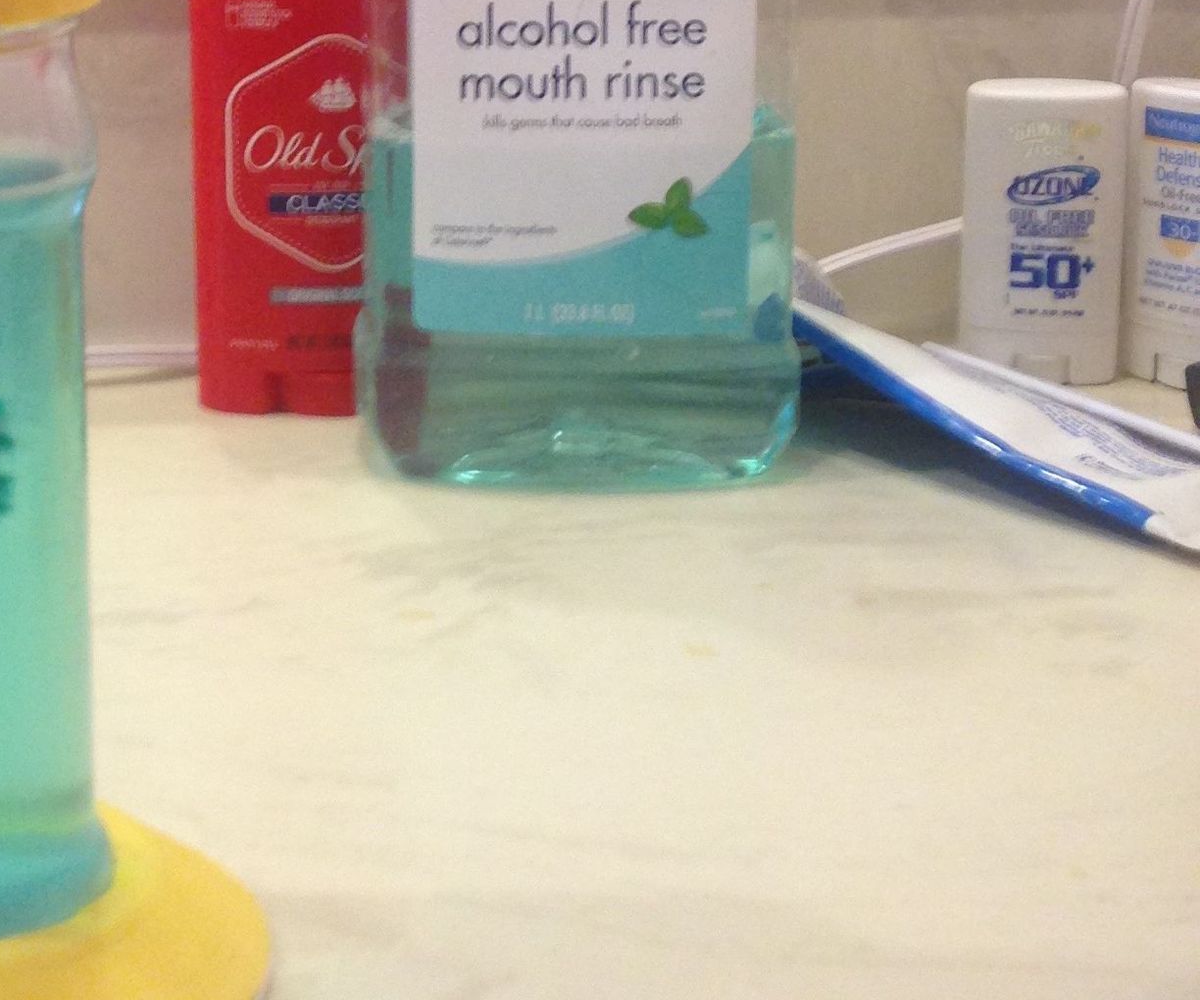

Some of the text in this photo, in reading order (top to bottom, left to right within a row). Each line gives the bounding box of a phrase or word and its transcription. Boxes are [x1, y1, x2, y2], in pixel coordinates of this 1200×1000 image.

[457, 0, 707, 47] alcohol free
[459, 54, 706, 100] mouth rinse
[616, 113, 639, 128] bad
[644, 113, 682, 128] breath
[243, 124, 321, 173] Old
[1011, 175, 1095, 197] OZONE
[1010, 252, 1096, 289] 50+
